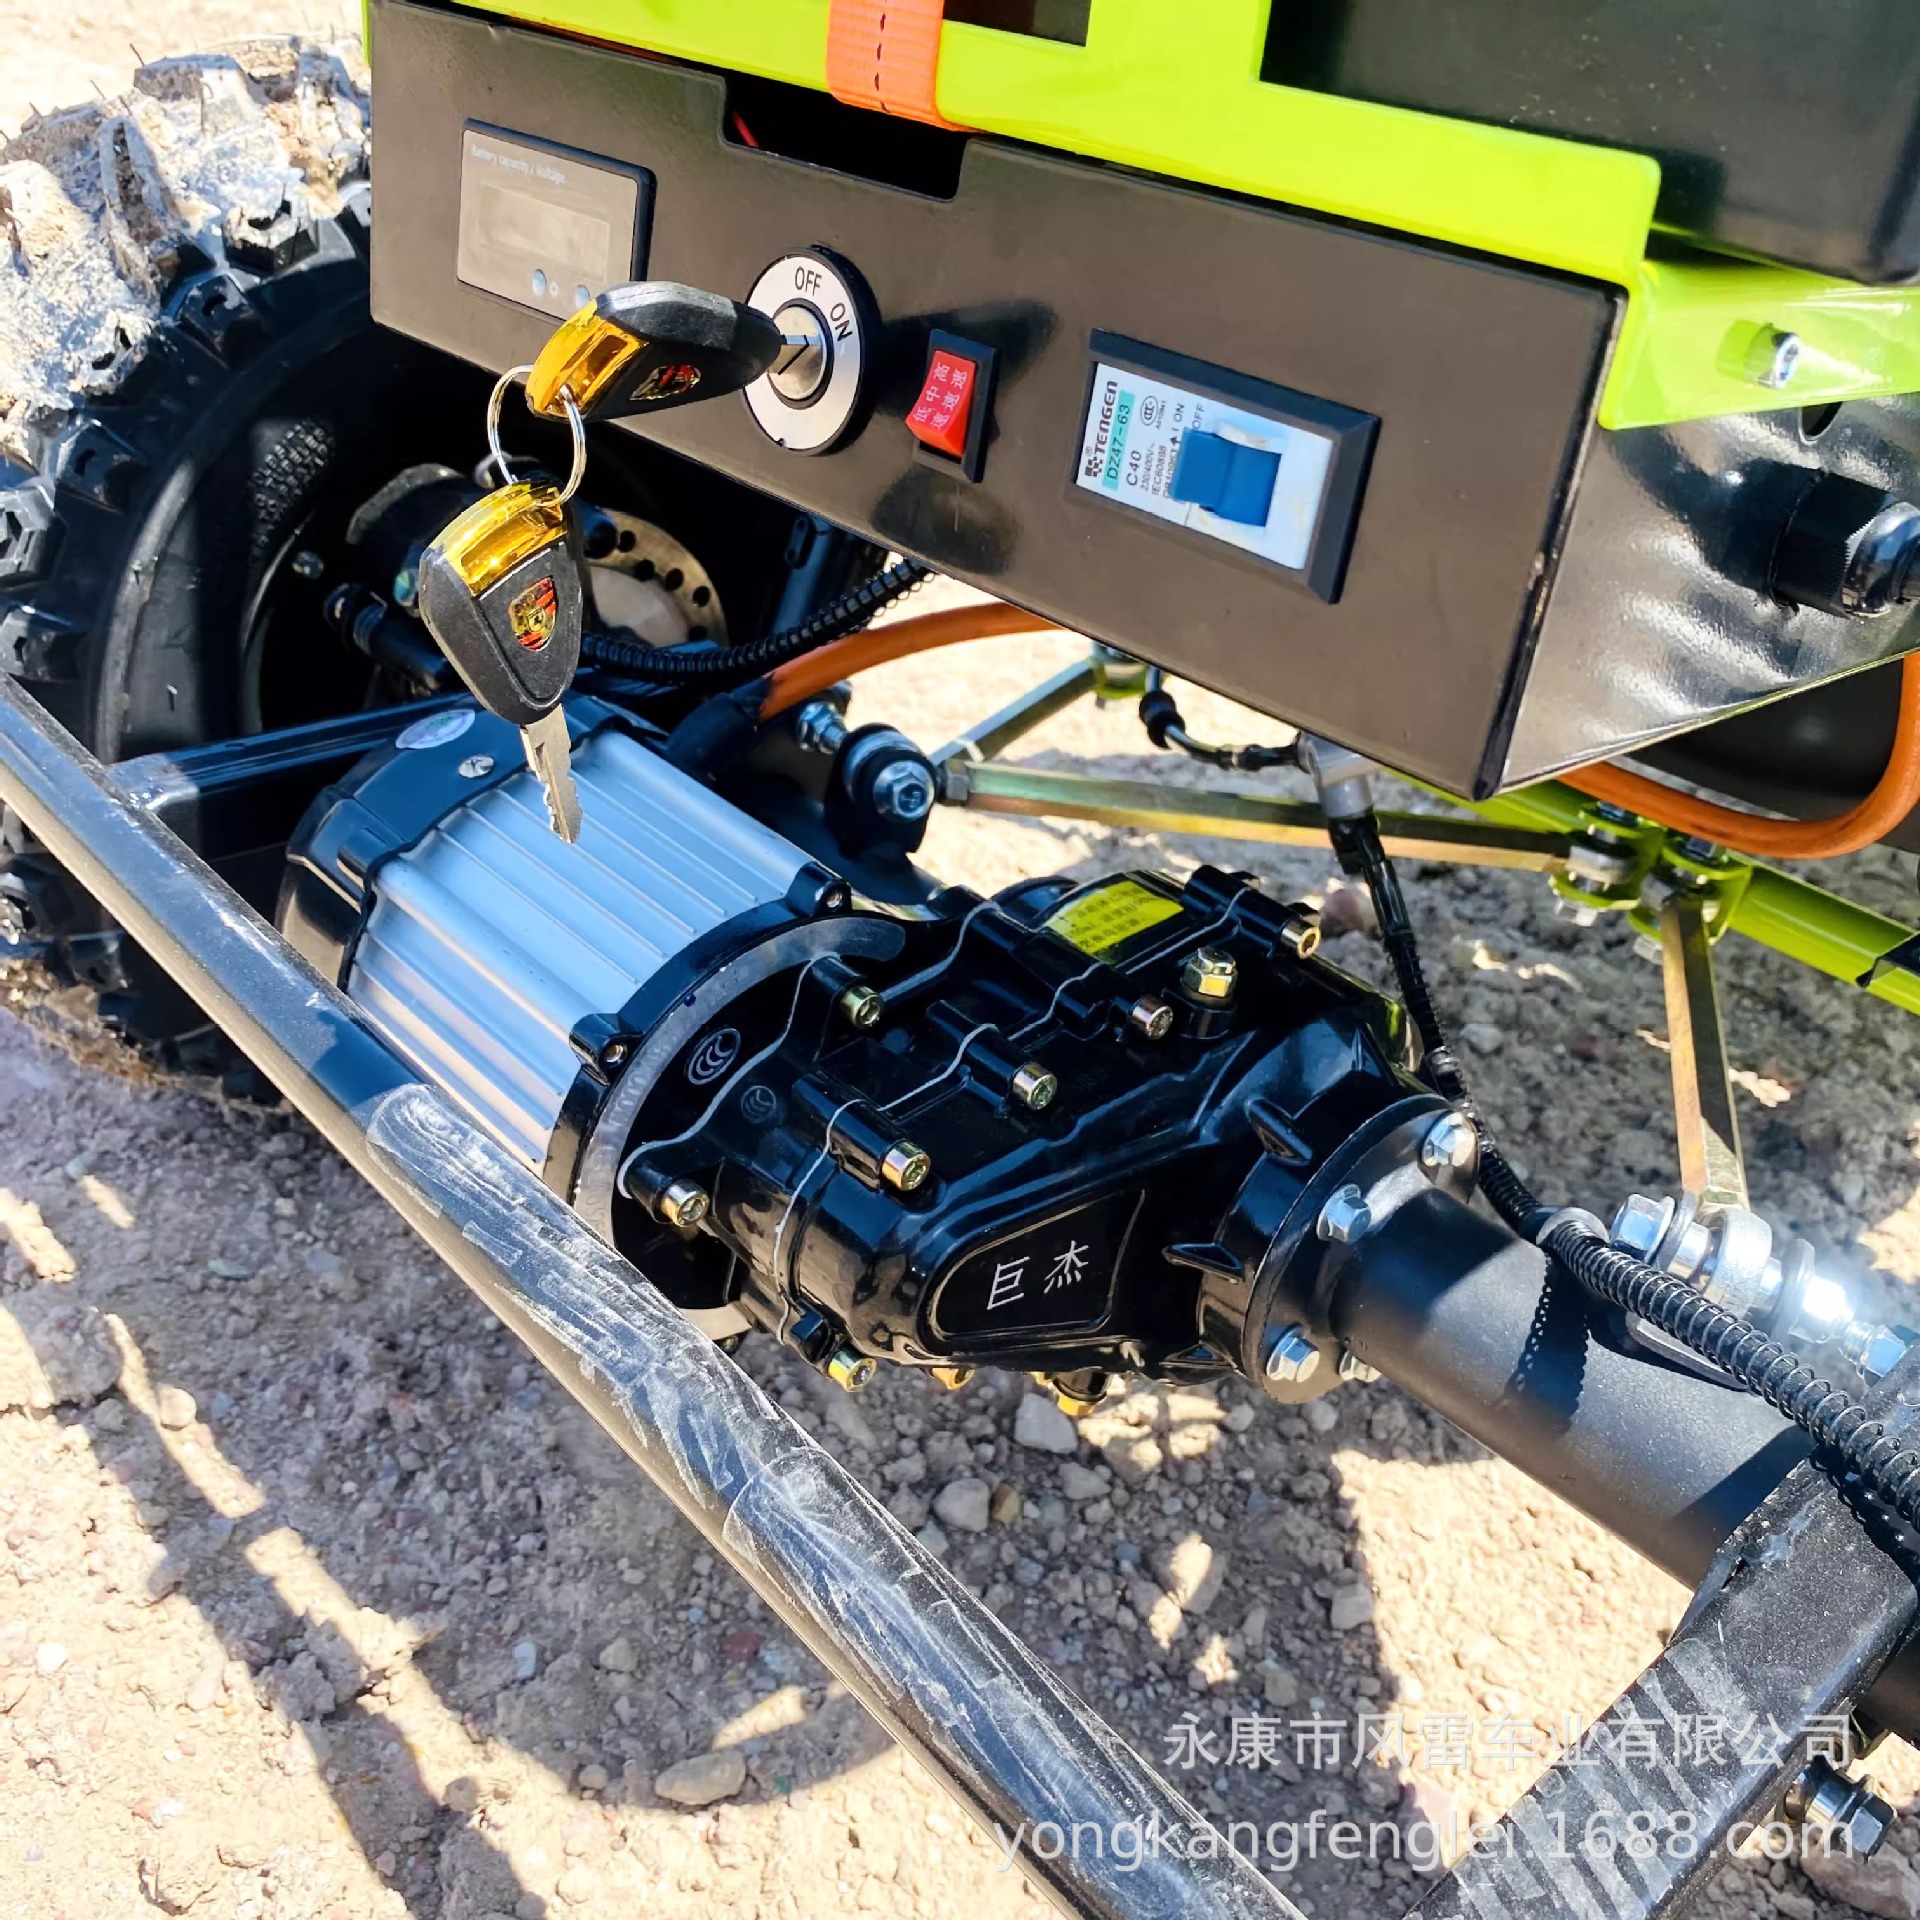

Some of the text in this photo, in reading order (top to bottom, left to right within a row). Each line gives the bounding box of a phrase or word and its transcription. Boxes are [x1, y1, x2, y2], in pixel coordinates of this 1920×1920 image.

[795, 266, 822, 296] OFF
[830, 303, 852, 342] ON
[1094, 380, 1118, 455] TENGEN
[1173, 403, 1185, 423] ON
[1192, 403, 1205, 430] OFF
[1106, 404, 1131, 480] DZ47-63
[1126, 450, 1142, 486] C40
[987, 1240, 1089, 1310] 巨杰
